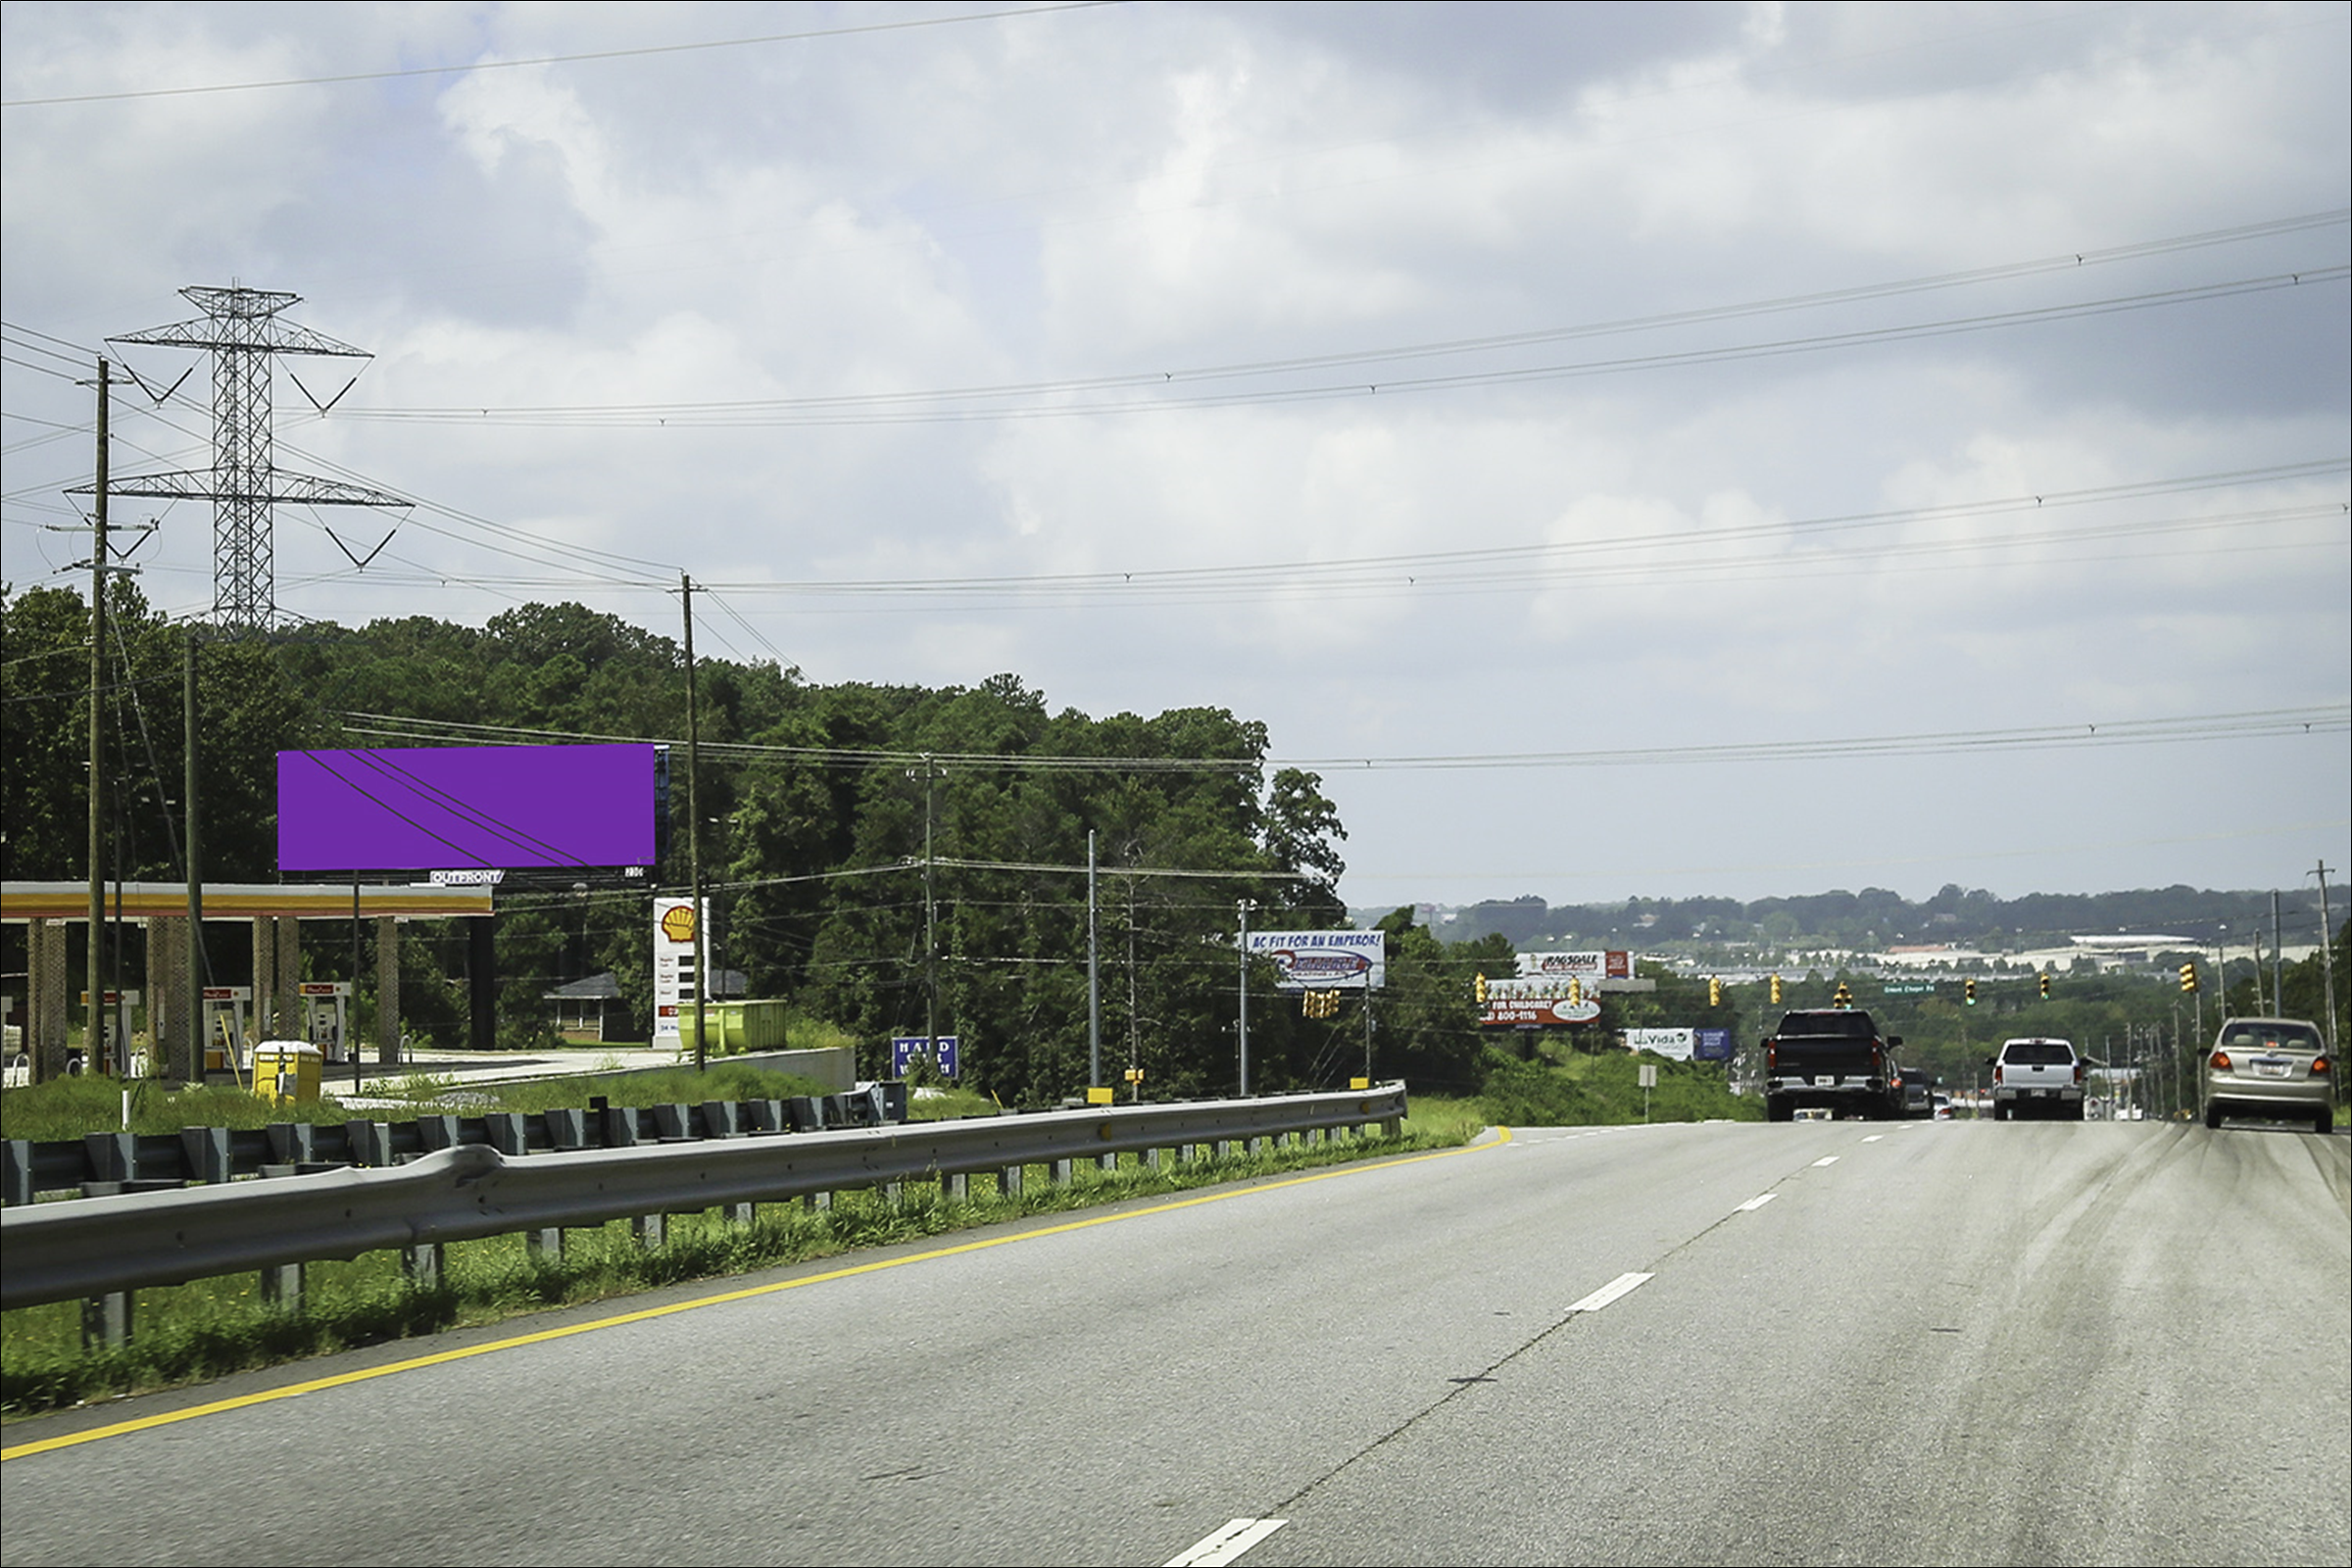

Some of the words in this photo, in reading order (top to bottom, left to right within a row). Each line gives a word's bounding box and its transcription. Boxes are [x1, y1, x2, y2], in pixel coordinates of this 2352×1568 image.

[1253, 937, 1267, 948] AC
[1269, 936, 1286, 948] FIT
[1288, 935, 1308, 948] FOR
[1310, 935, 1325, 947] AN
[1328, 934, 1382, 947] EMPEROR!
[1546, 955, 1597, 965] RAGSDALE
